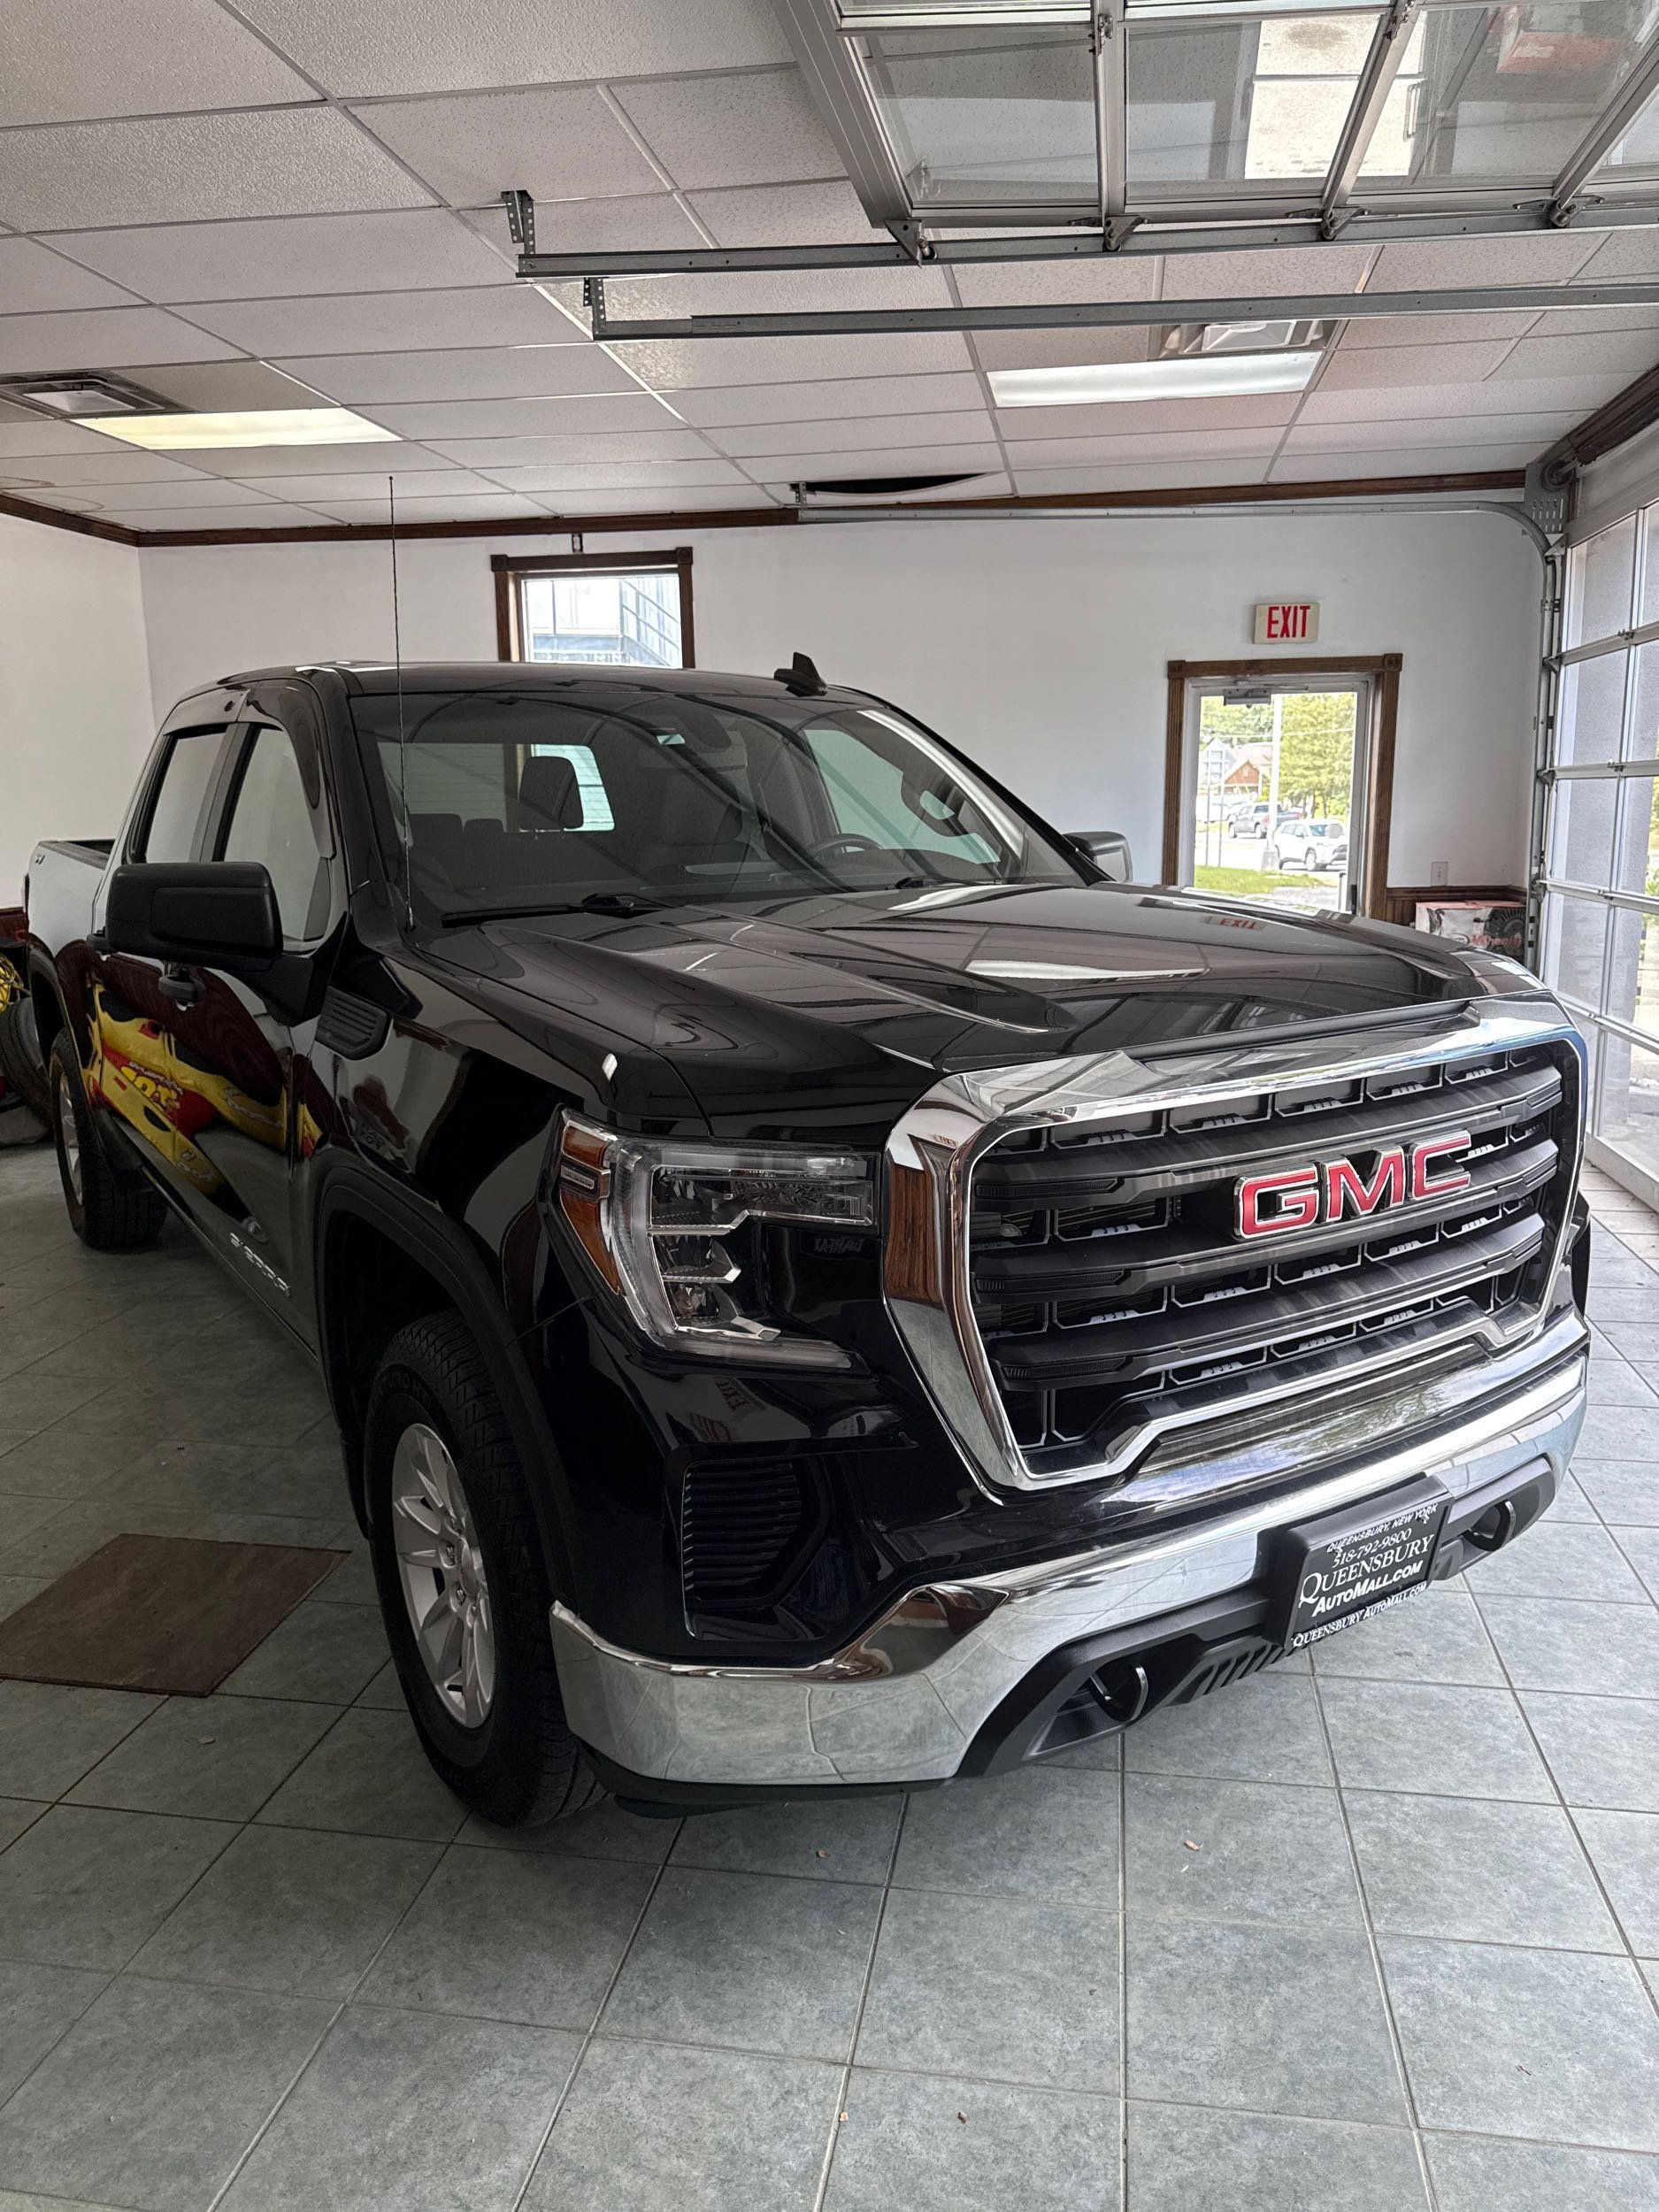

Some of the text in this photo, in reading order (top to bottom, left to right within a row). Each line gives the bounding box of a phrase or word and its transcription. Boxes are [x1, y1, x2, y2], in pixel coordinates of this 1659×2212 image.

[1267, 605, 1310, 638] EXIT
[1236, 1130, 1472, 1239] GMC
[1327, 1503, 1439, 1553] QUEENSBURY, NEW YORK
[1332, 1528, 1412, 1569] 518-792-9800
[1298, 1533, 1435, 1608] QUEENSBURY
[1312, 1561, 1424, 1617] AUTOMALL.COM
[1293, 1610, 1363, 1647] QUEENSBURY
